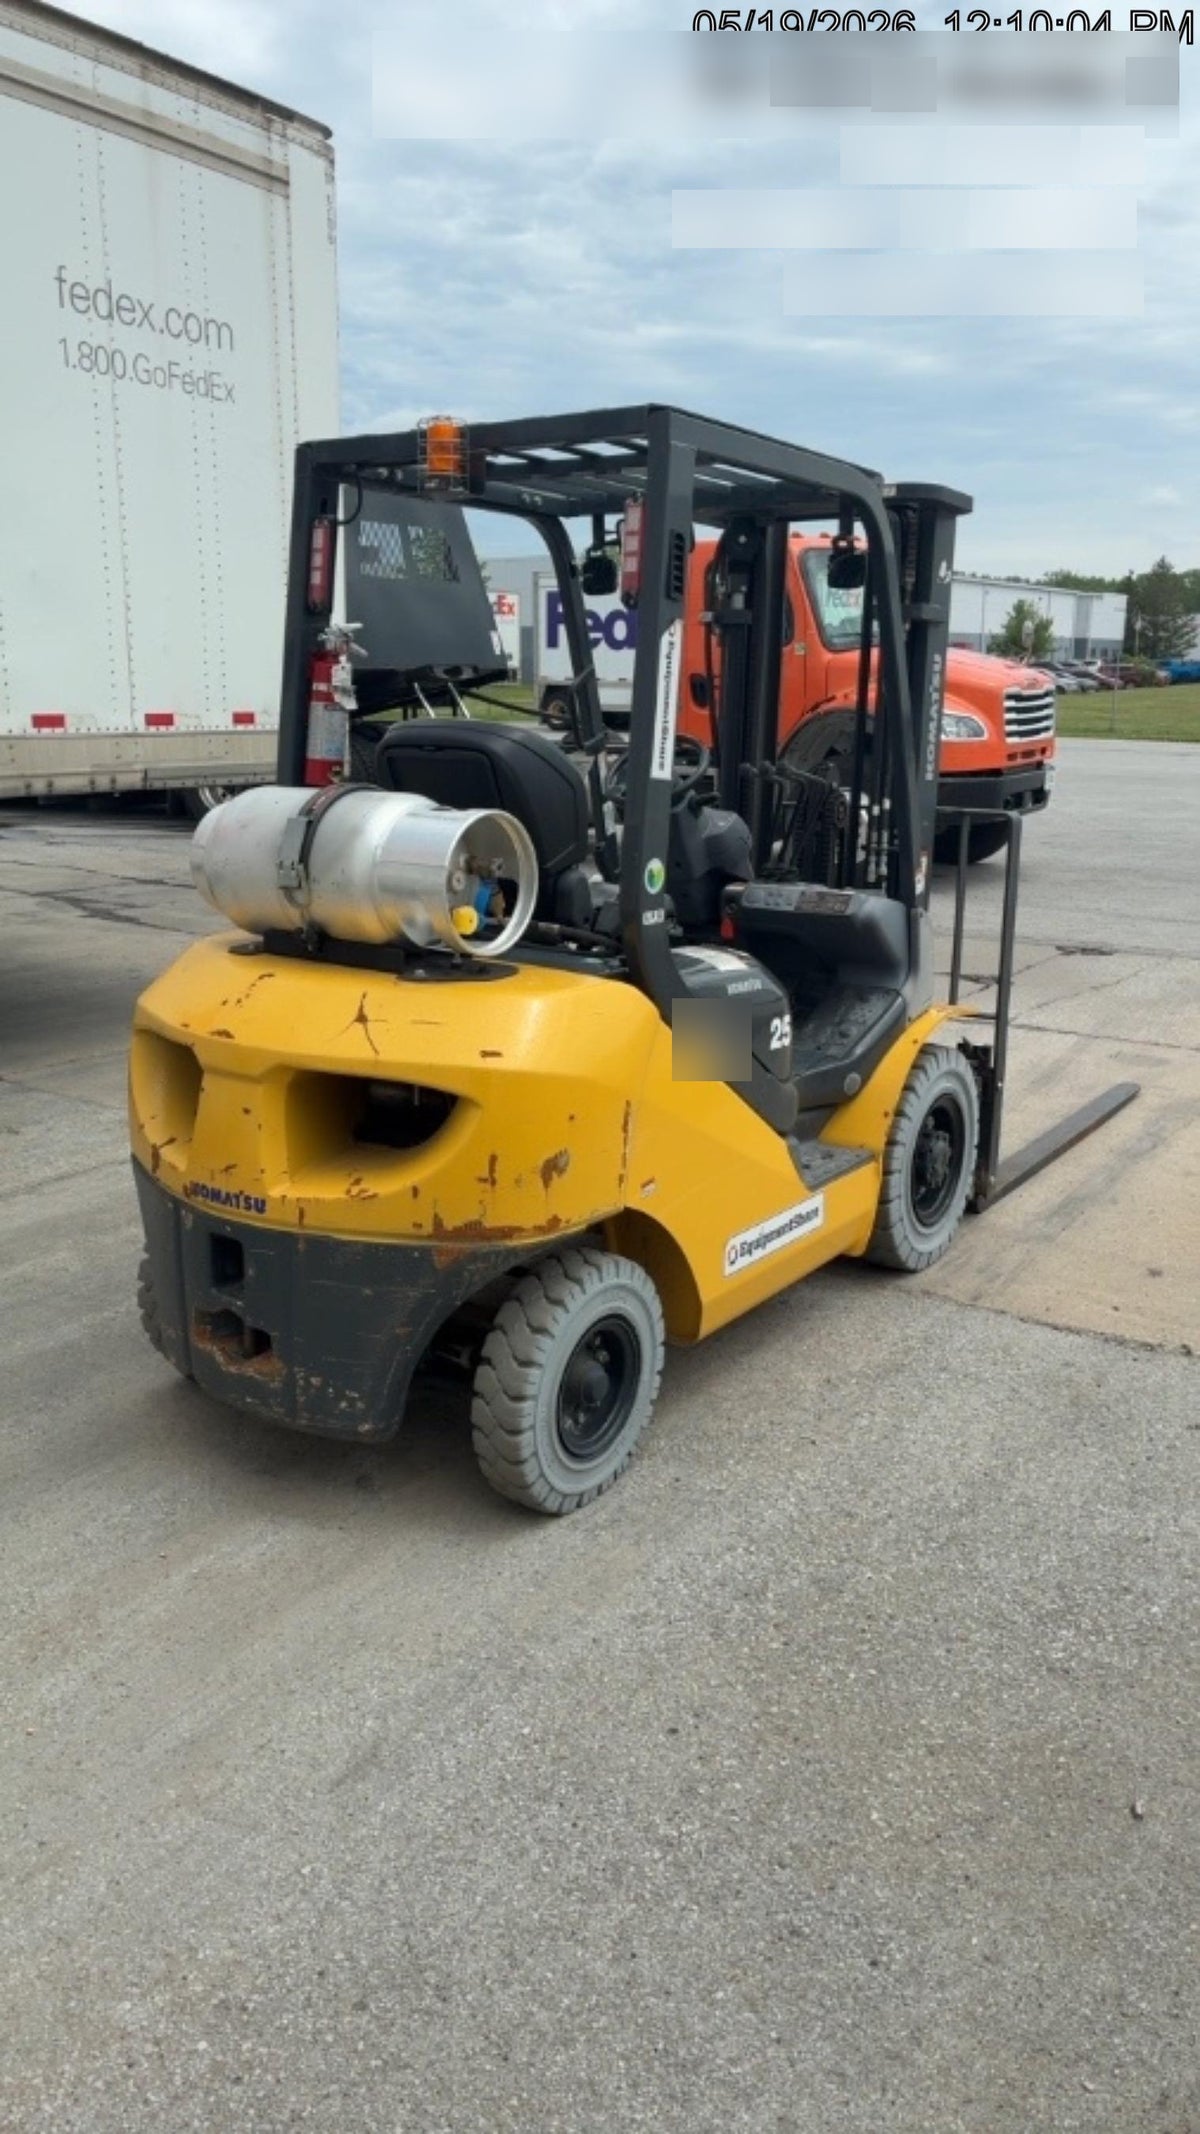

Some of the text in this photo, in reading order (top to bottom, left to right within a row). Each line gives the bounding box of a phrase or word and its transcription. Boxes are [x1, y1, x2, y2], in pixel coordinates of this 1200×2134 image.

[53, 264, 234, 351] fedex.com
[58, 337, 235, 403] 1.800.GoFedEx
[924, 652, 943, 782] KOMATSU
[769, 1013, 793, 1051] 25
